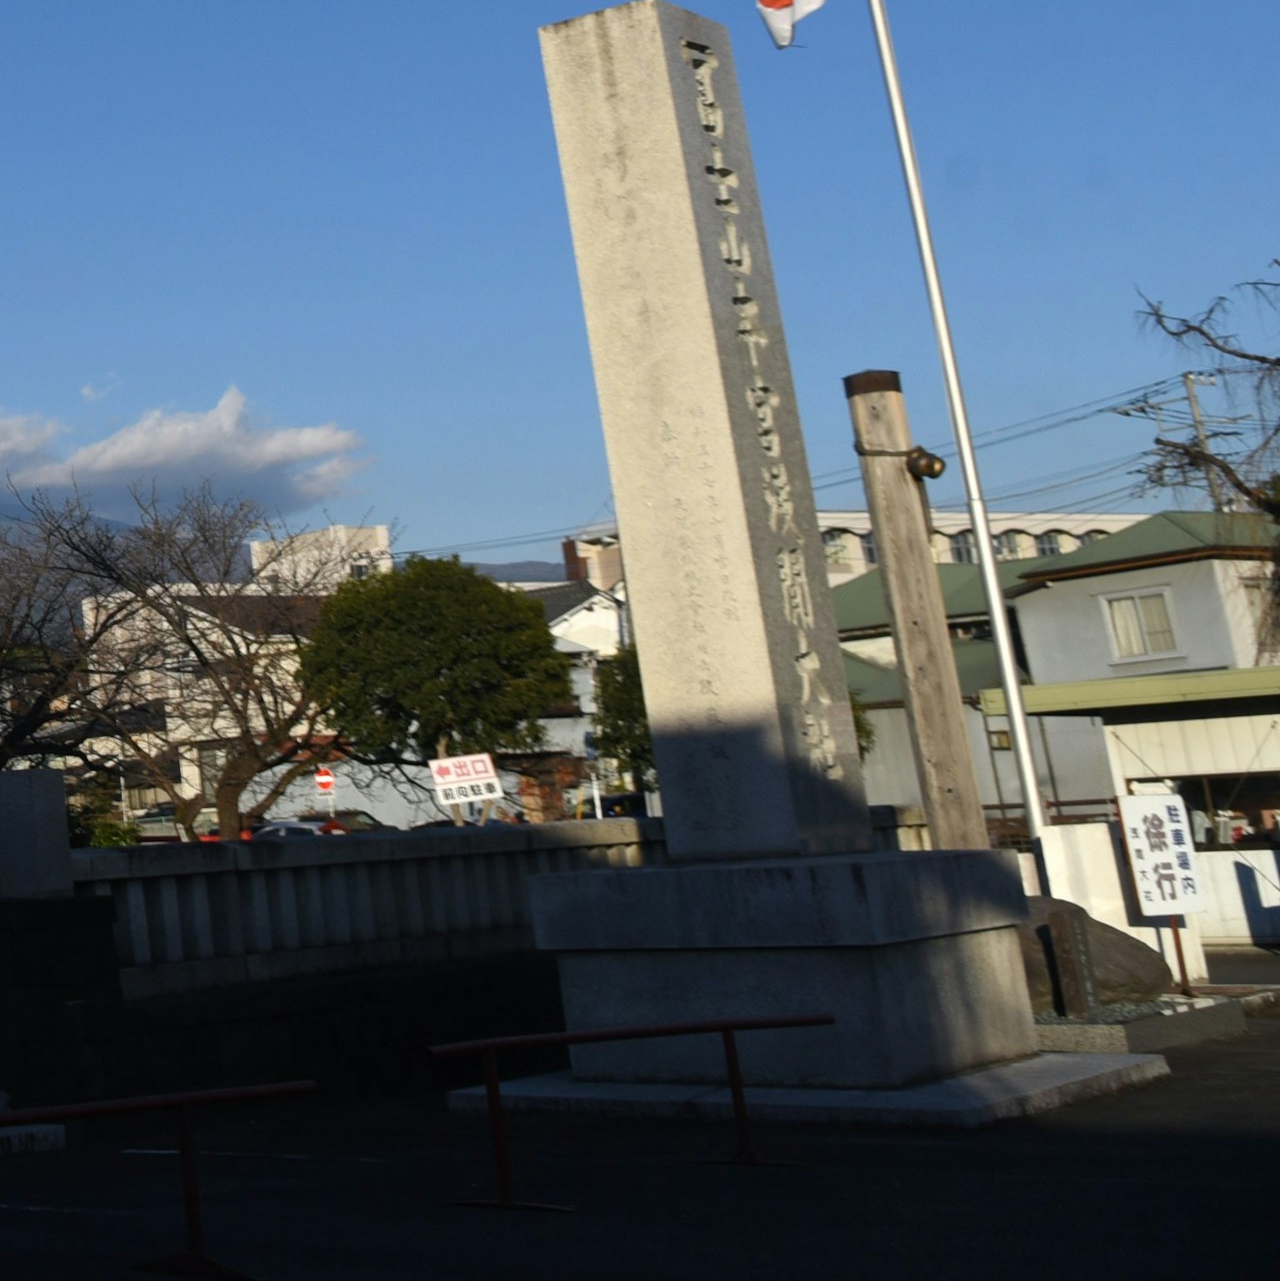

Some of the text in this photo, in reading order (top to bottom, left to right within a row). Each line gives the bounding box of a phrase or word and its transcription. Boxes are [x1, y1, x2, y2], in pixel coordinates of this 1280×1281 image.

[441, 781, 498, 801] 前向駐車
[453, 758, 491, 778] 出口
[1141, 812, 1179, 902] 徐行
[1164, 804, 1198, 895] 駐車場内
